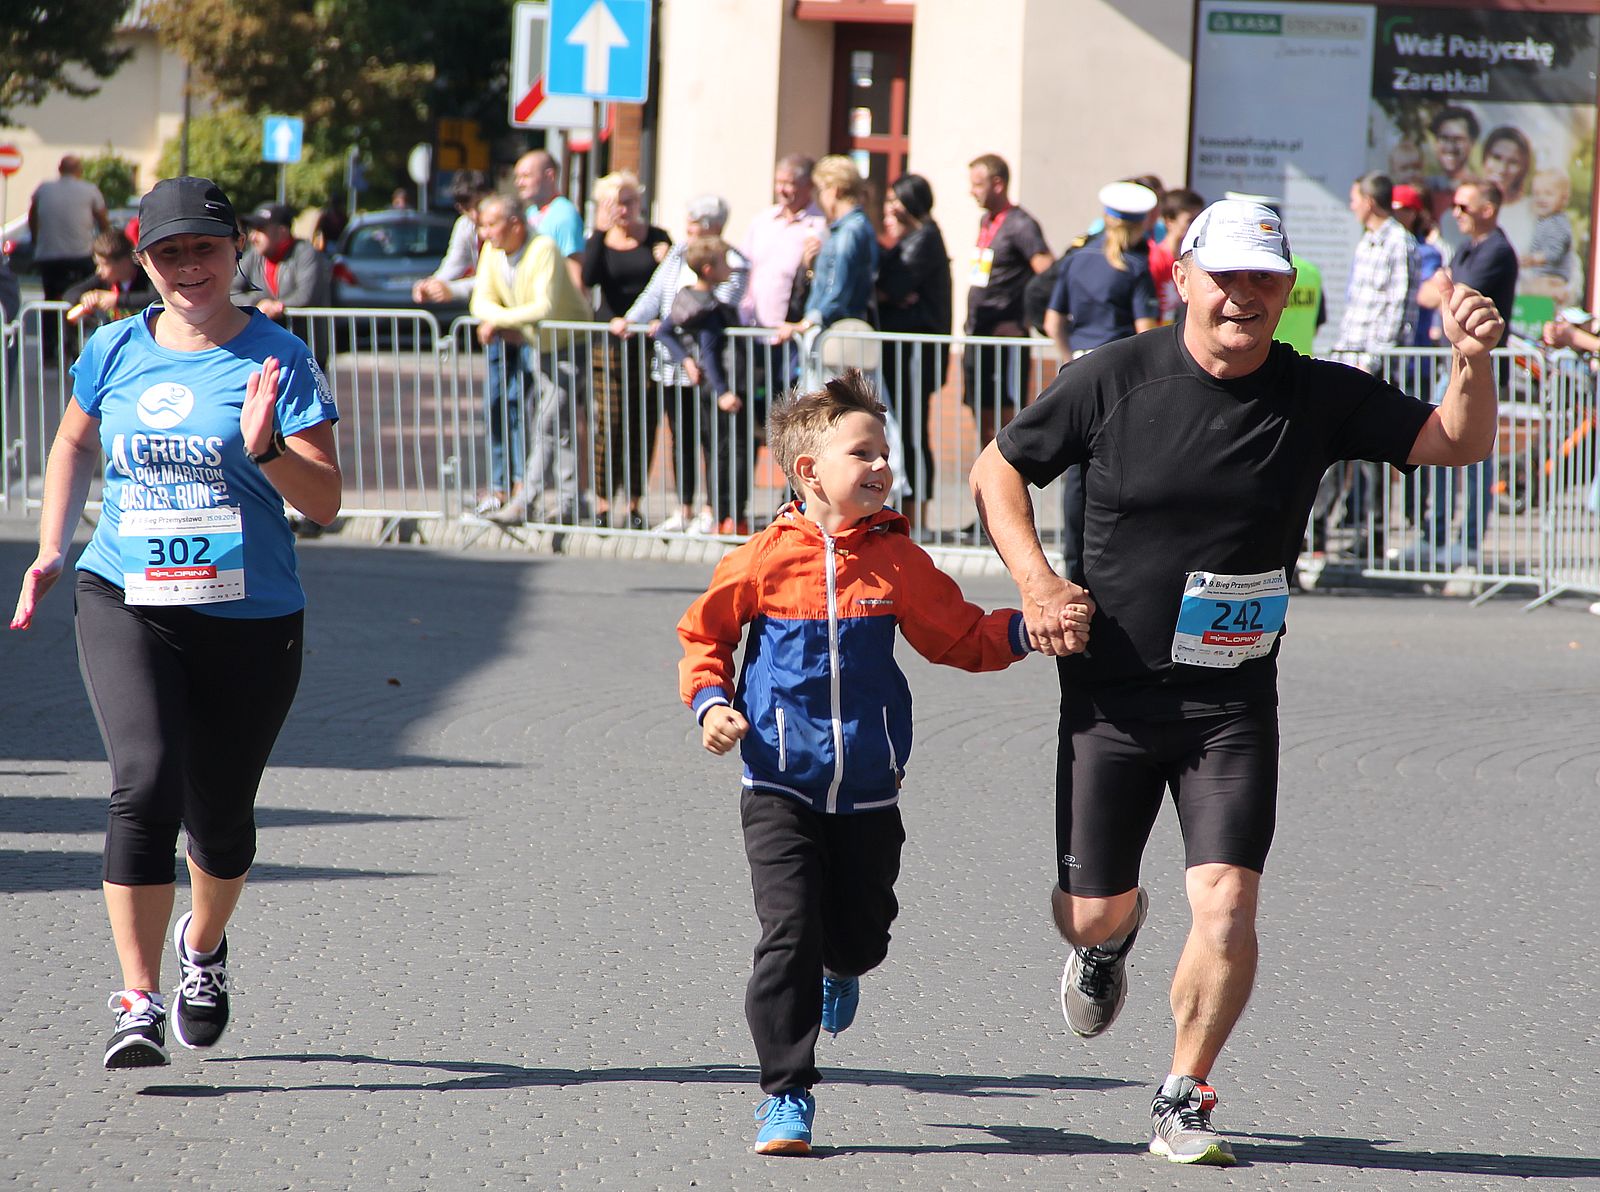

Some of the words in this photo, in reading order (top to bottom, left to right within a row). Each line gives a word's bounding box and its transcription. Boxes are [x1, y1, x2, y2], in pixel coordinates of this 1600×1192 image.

[1394, 32, 1445, 56] Weź
[1450, 35, 1555, 67] Pożyczkę
[1392, 67, 1490, 93] Zaratka!
[131, 433, 223, 467] CROSS
[135, 463, 225, 487] PÓŁMARATON
[120, 484, 211, 509] BASTER-RUN
[147, 536, 212, 566] 302
[160, 570, 210, 578] FLORINA
[1216, 581, 1229, 589] Bieg
[1211, 601, 1263, 631] 242
